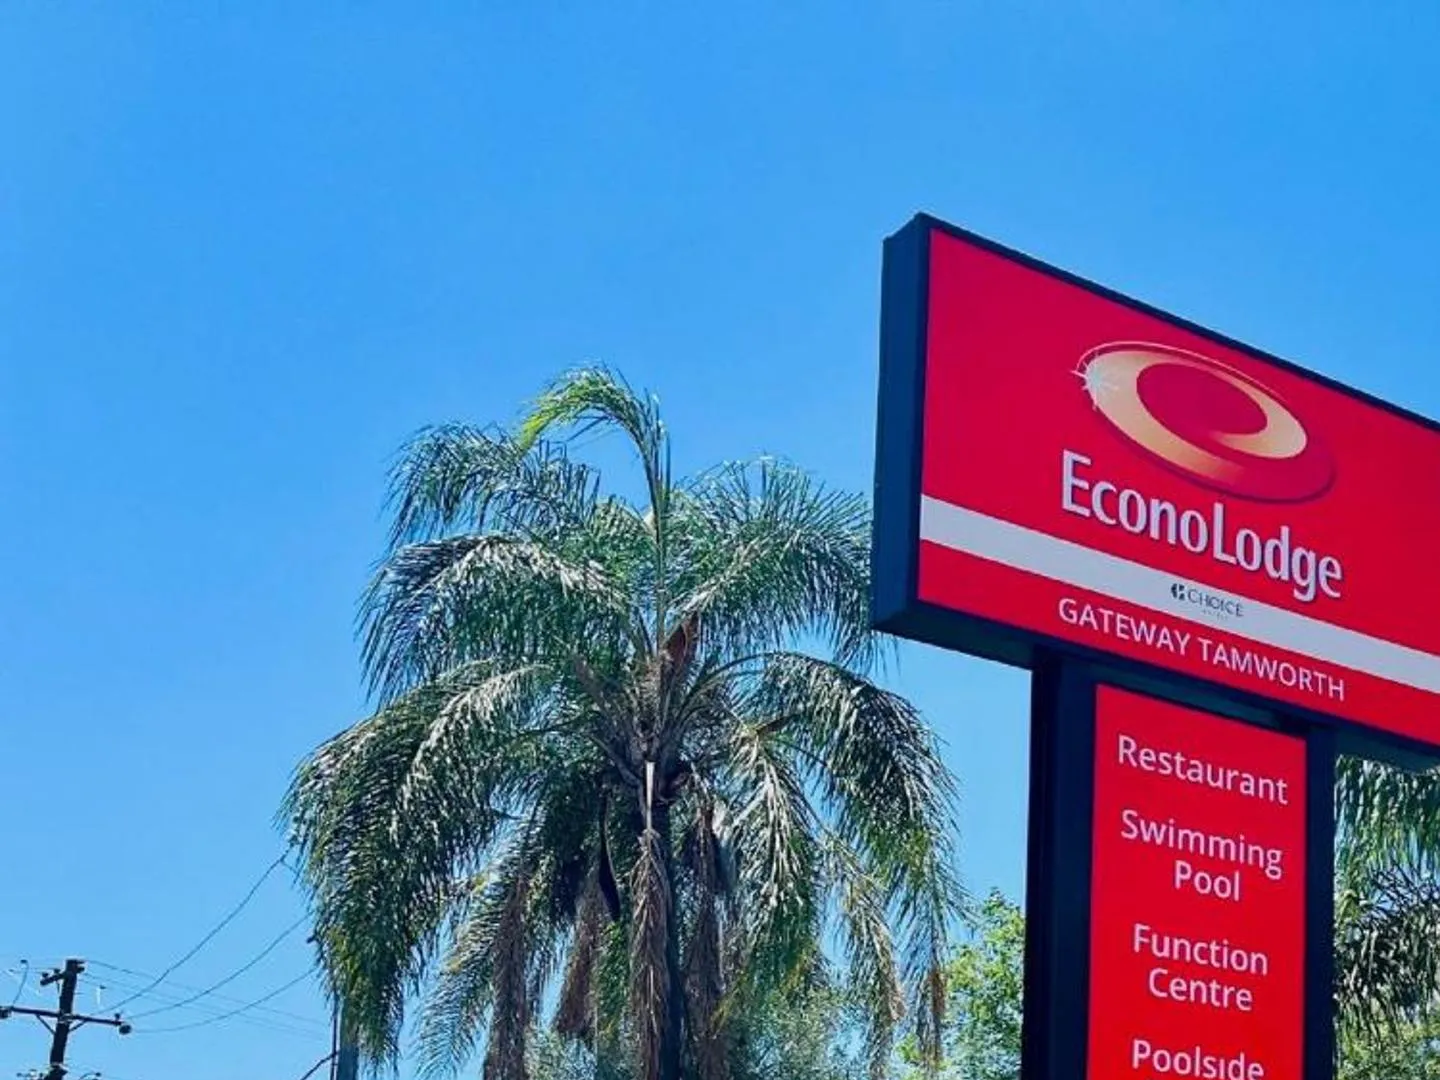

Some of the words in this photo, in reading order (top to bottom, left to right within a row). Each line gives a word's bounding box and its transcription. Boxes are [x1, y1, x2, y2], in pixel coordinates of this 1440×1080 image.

[1061, 449, 1343, 602] EconoLodge
[1188, 588, 1245, 617] CHOICE
[1058, 598, 1191, 656] GATEWAY
[1197, 637, 1345, 701] TAMWORTH
[1117, 734, 1289, 805] Restaurant
[1120, 809, 1283, 881] Swimming
[1174, 860, 1241, 902] Pool
[1133, 922, 1269, 976] Function
[1149, 967, 1253, 1011] Centre
